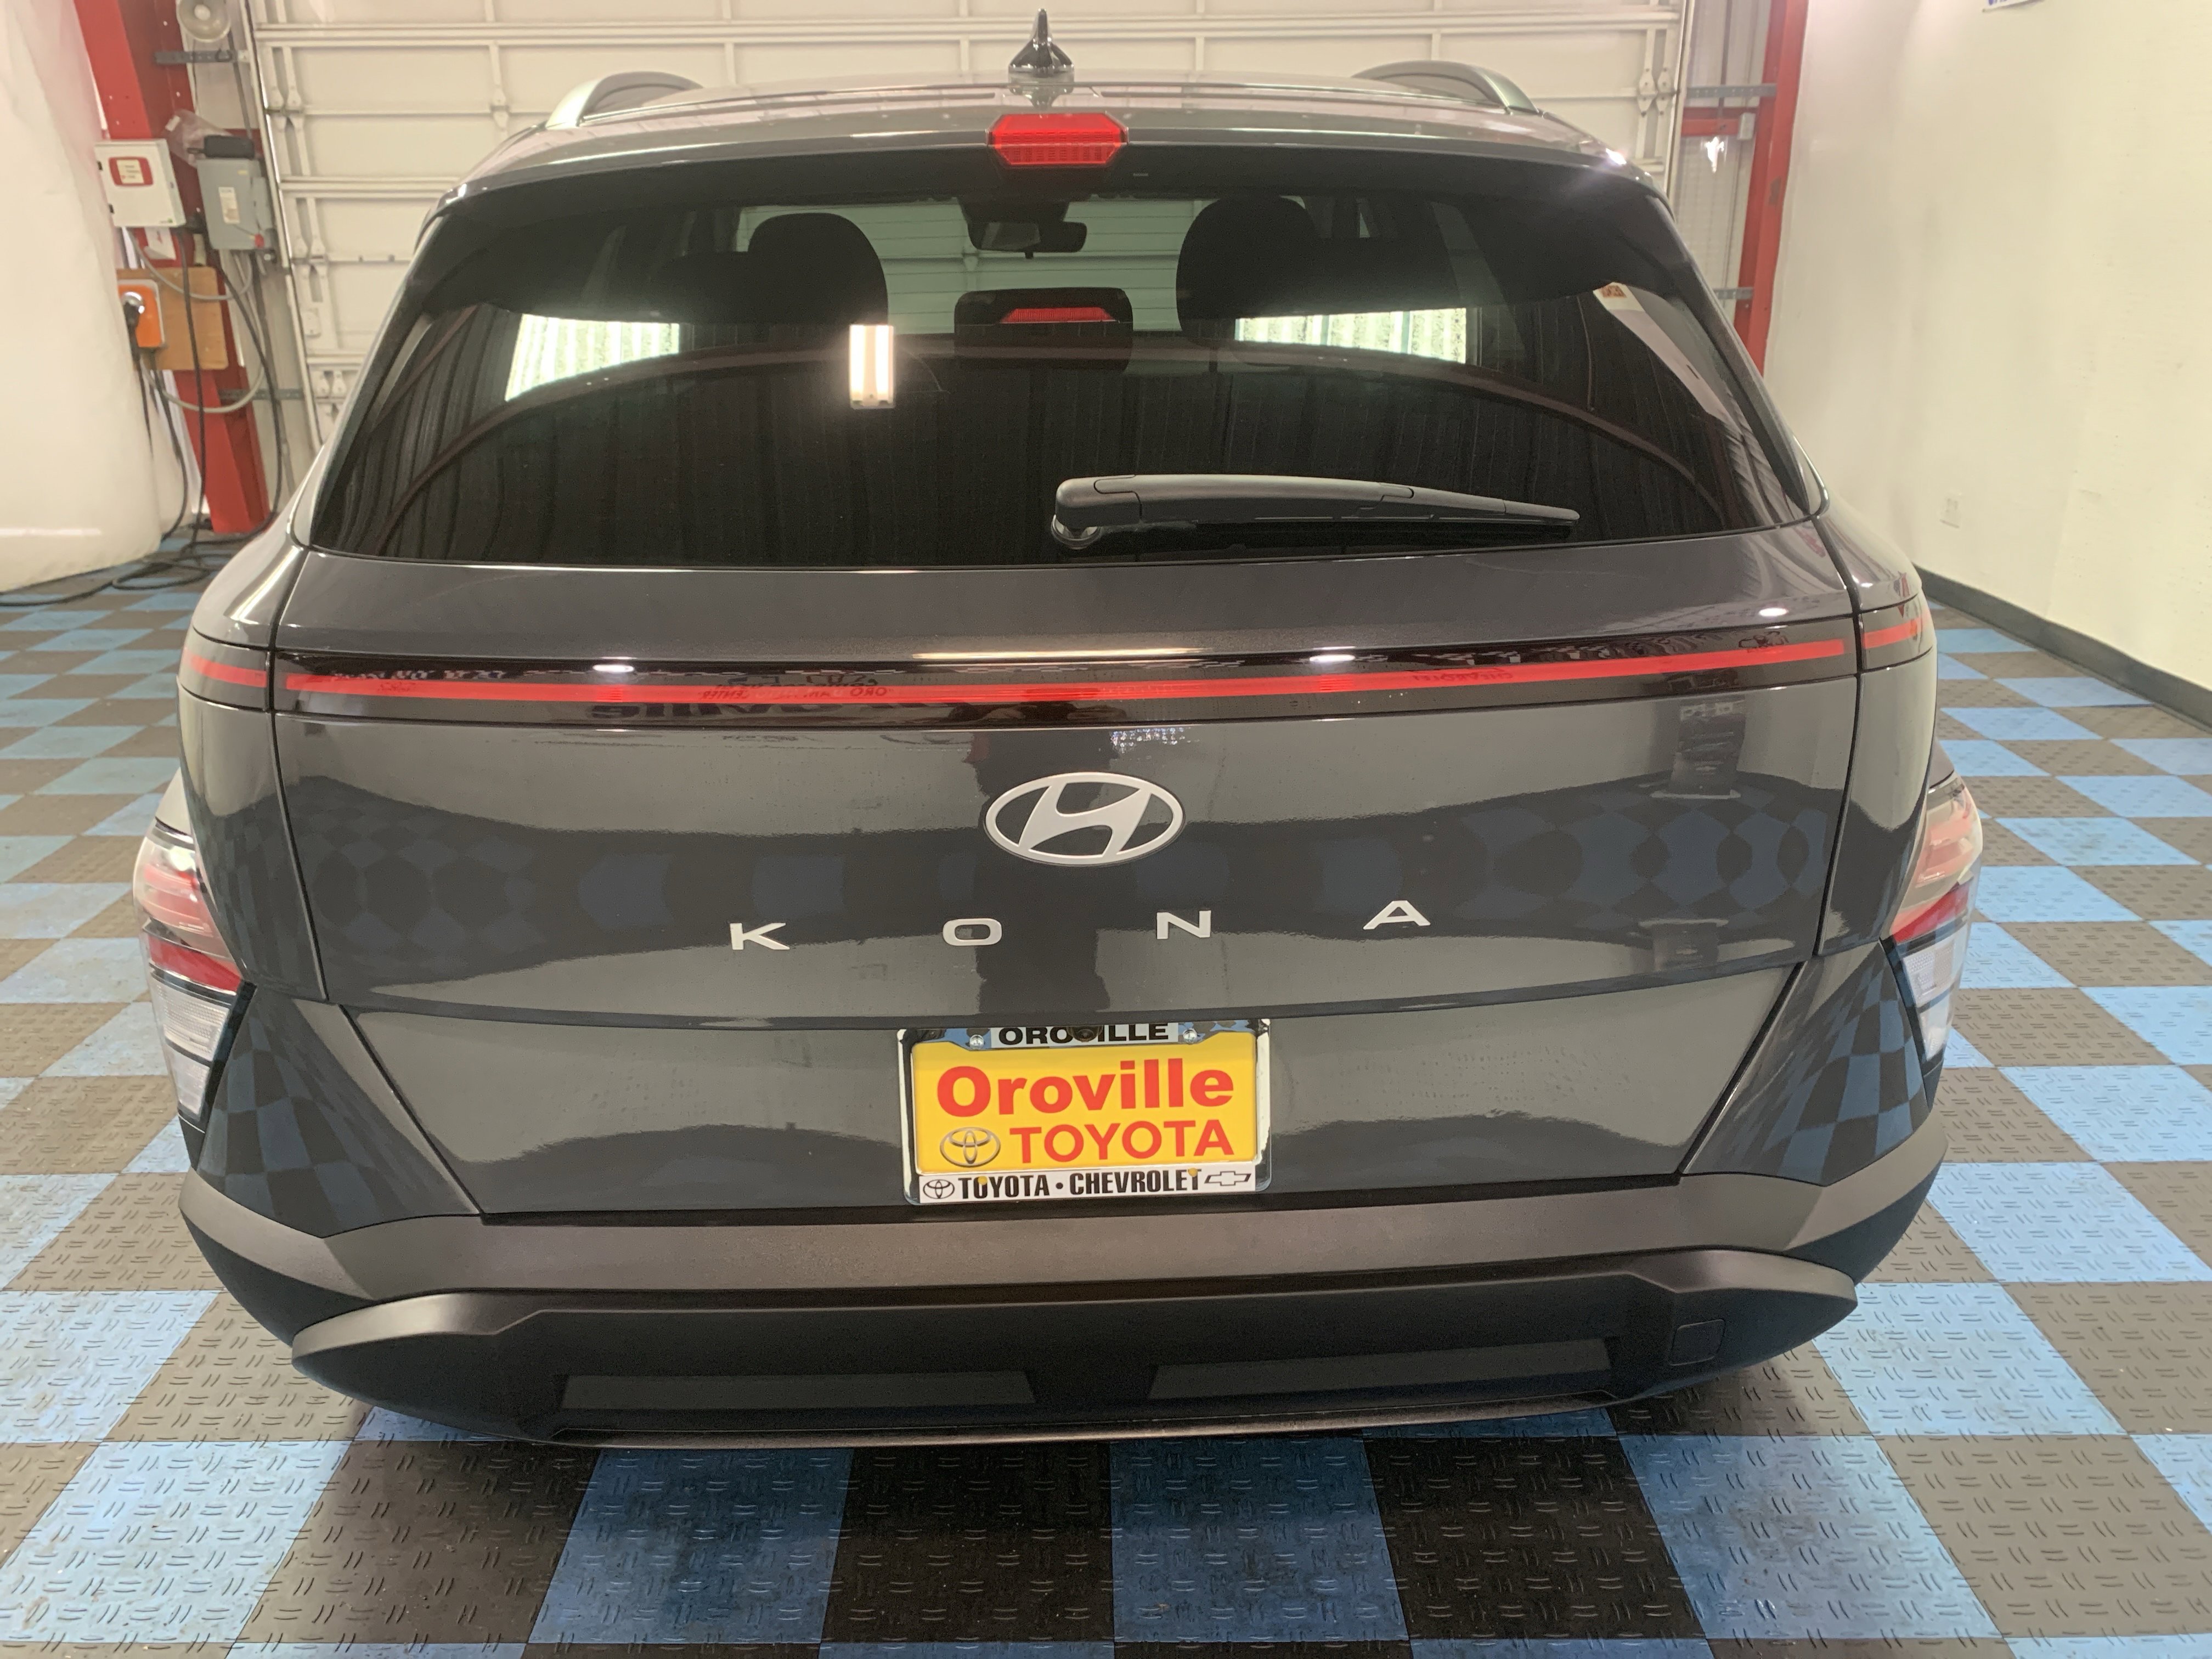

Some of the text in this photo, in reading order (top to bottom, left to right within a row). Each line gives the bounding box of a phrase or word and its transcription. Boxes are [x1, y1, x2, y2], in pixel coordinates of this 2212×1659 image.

[998, 1023, 1169, 1045] OROILLE
[936, 1058, 1234, 1117] Oroville
[1009, 1120, 1234, 1164] TOYOTA
[958, 1169, 1201, 1199] TOYOTA CHEVROLET
